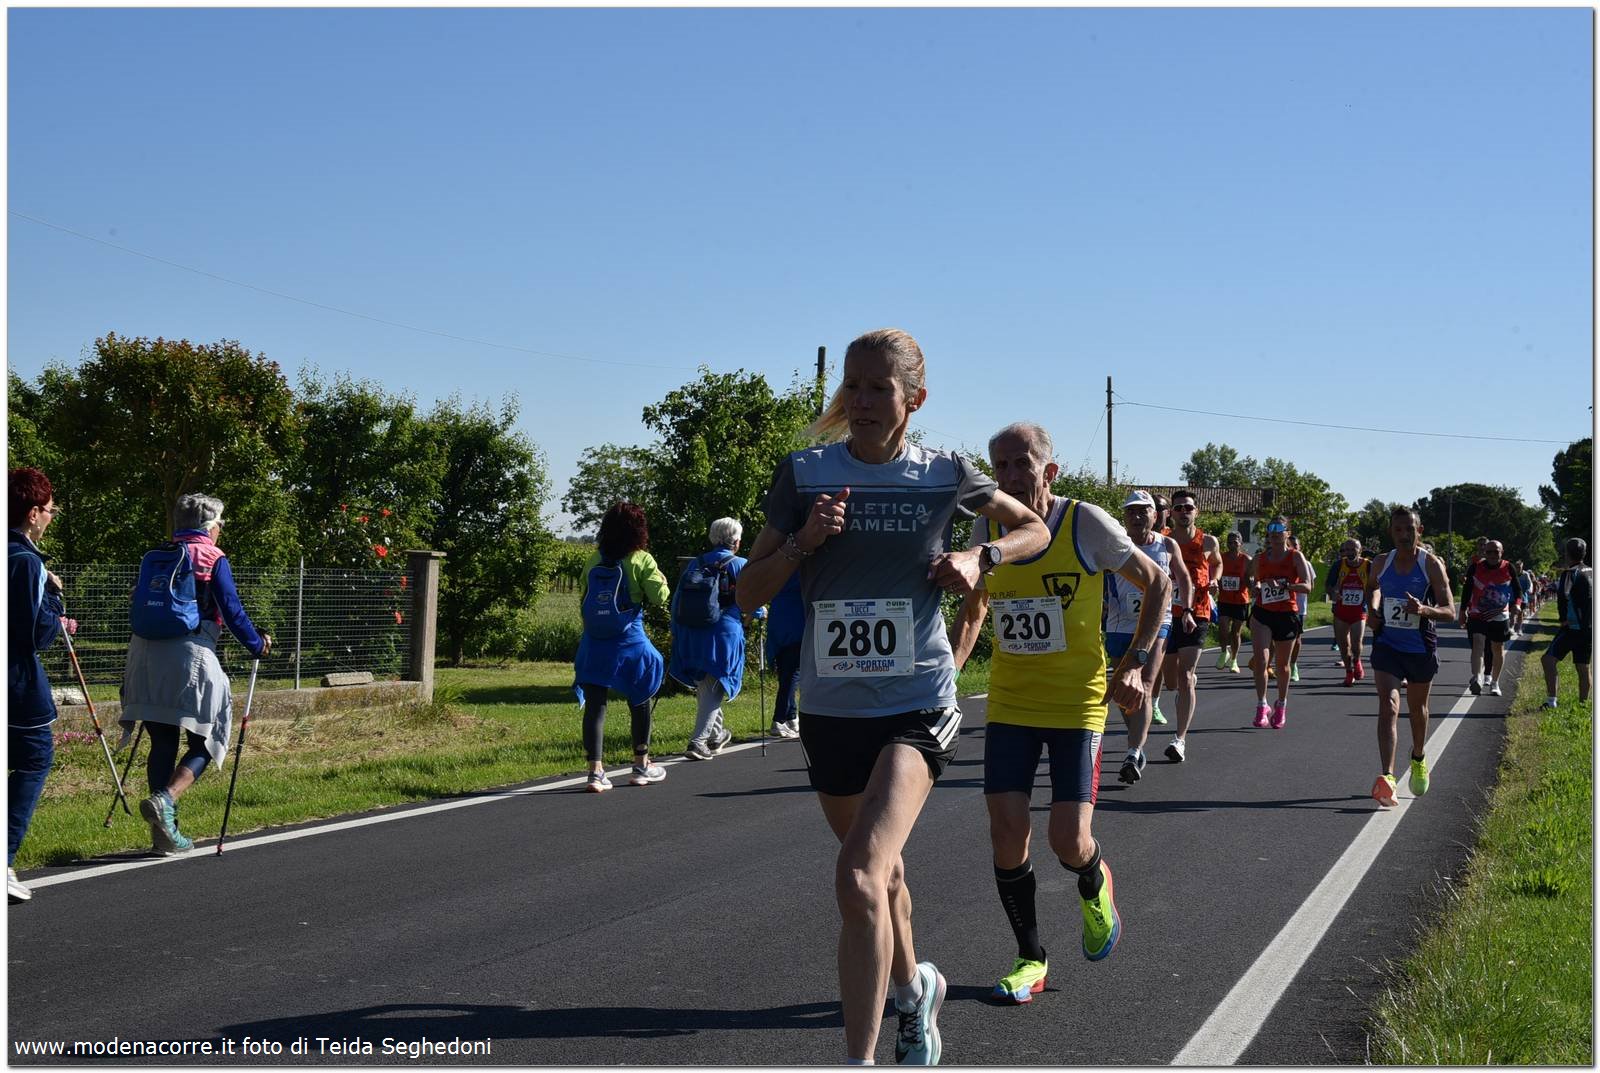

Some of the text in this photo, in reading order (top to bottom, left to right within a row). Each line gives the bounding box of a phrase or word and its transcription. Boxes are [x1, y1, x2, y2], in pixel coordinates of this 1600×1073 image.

[847, 502, 926, 515] LETICA
[1344, 593, 1360, 601] 275
[1000, 612, 1051, 640] 230
[827, 619, 897, 657] 280
[856, 659, 895, 669] SPORTGM
